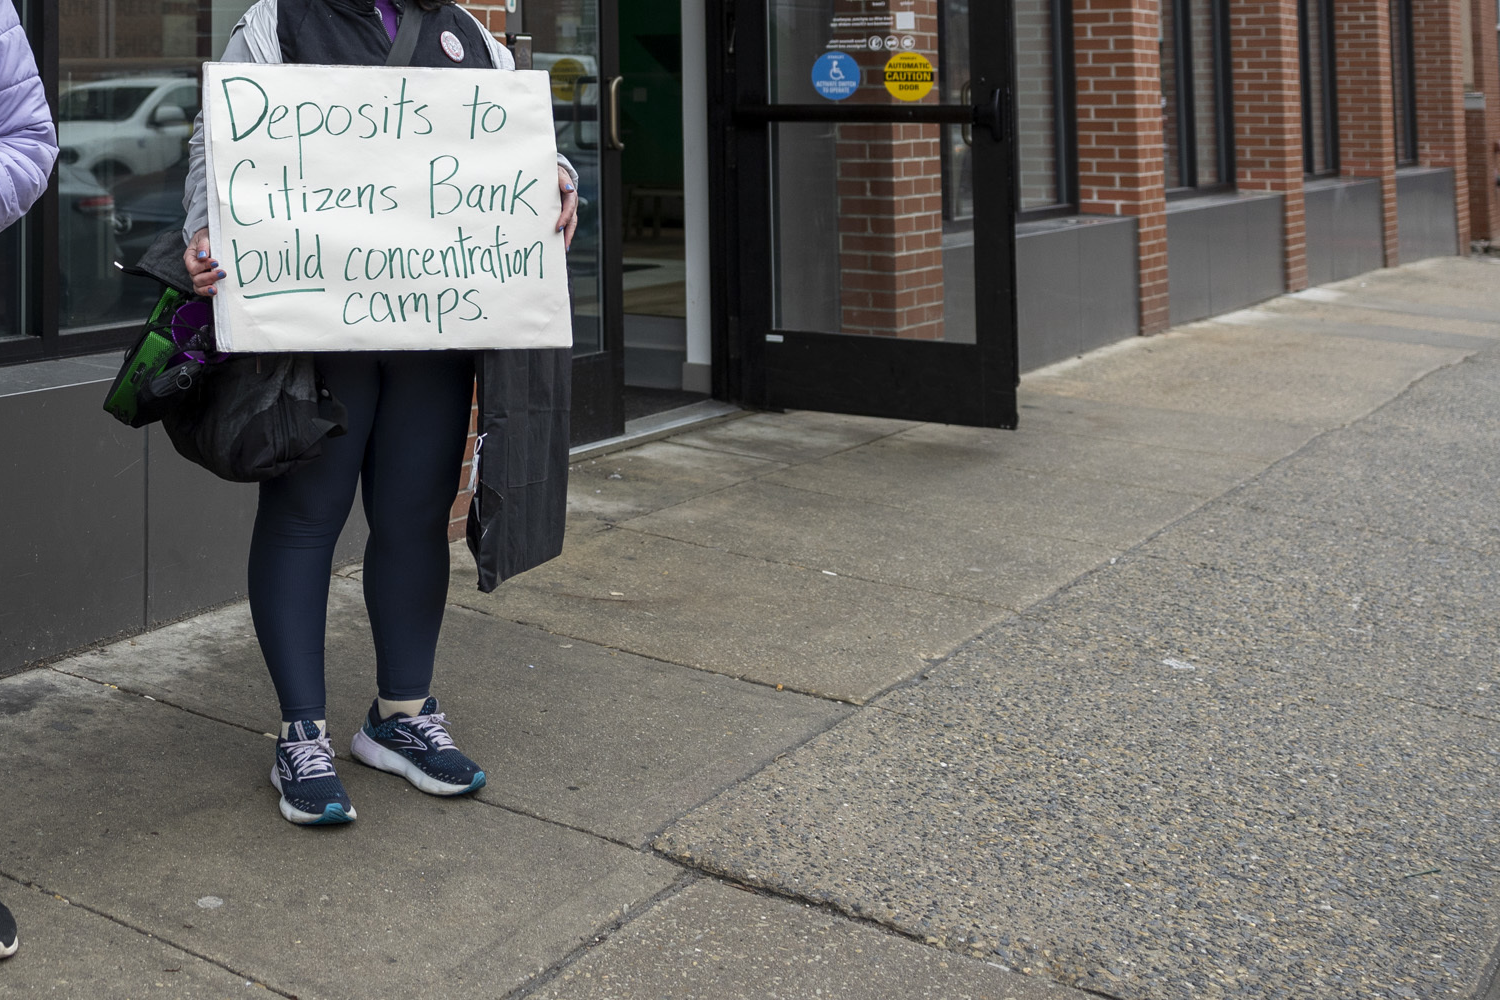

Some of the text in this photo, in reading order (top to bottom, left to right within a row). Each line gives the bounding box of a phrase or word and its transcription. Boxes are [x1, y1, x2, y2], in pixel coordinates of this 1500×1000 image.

[885, 72, 931, 81] CAUTION
[221, 76, 508, 180] Deposits to
[228, 154, 539, 227] Citizens Bank
[232, 225, 544, 288] build concentration
[343, 287, 488, 334] camps.
